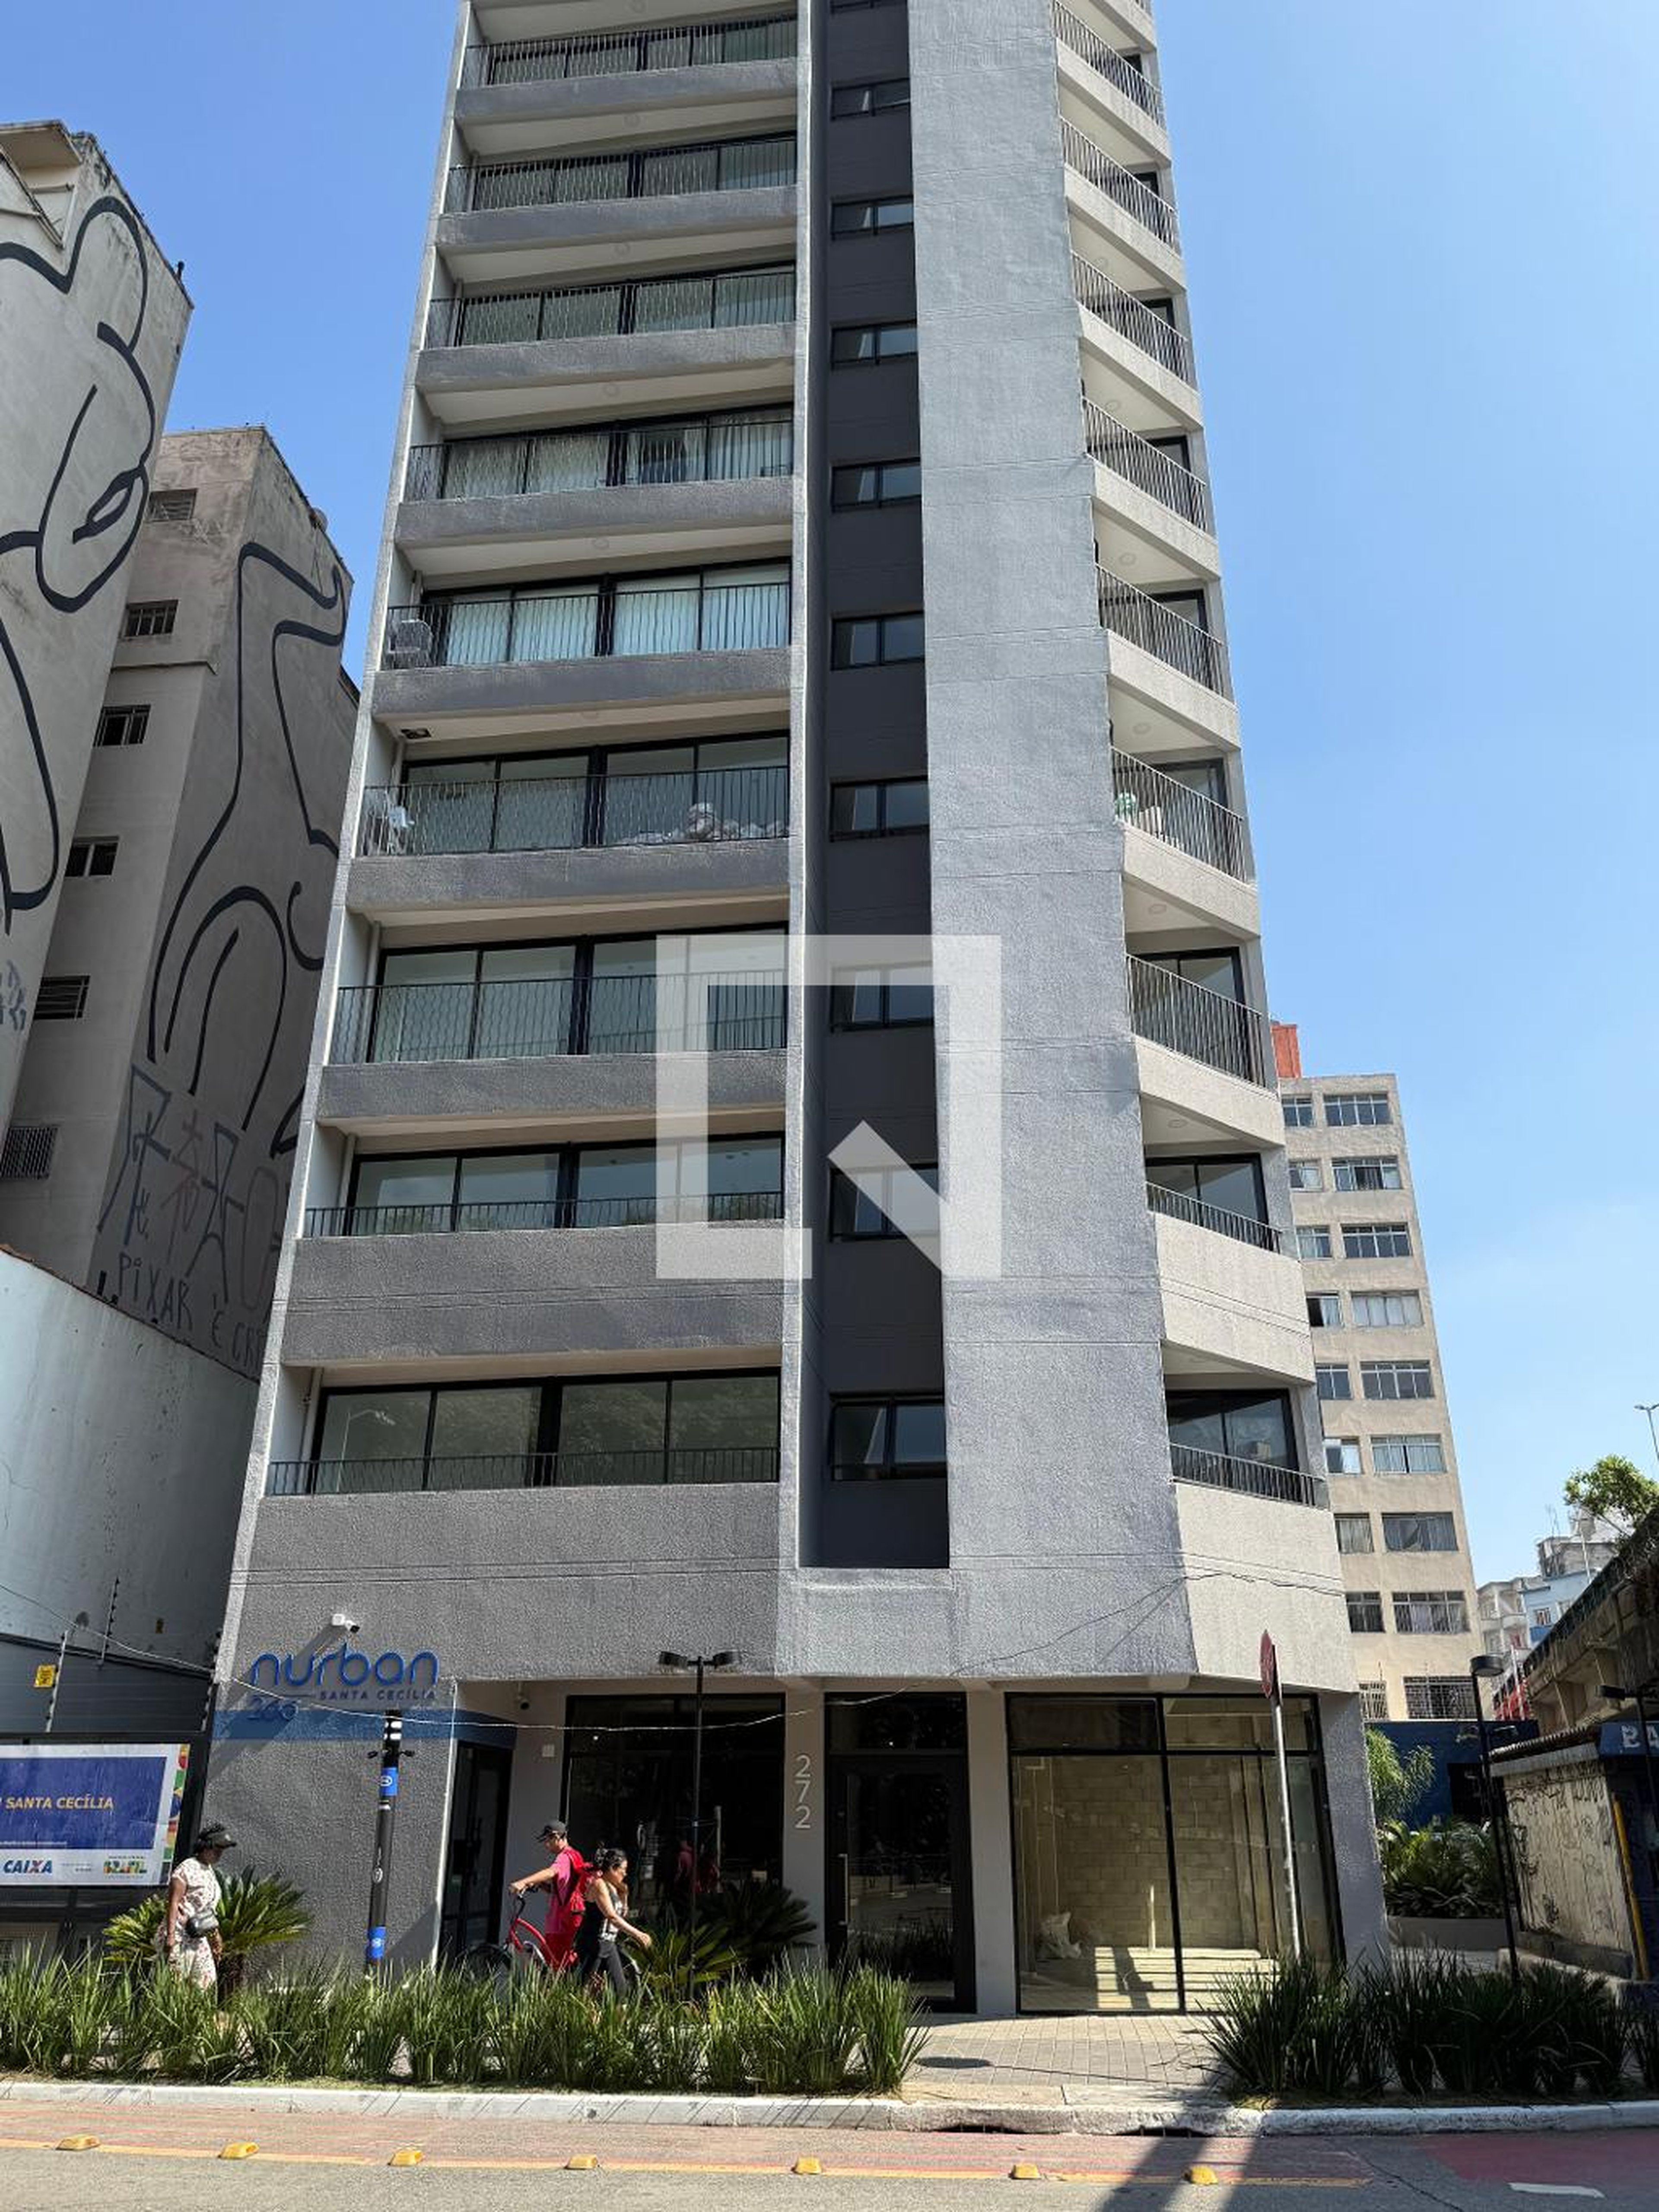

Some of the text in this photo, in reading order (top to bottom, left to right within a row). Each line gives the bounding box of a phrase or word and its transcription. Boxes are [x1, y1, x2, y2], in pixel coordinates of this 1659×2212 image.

[250, 1642, 439, 1686] nurban
[320, 1690, 368, 1700] SANTA
[795, 1754, 811, 1829] 272
[6, 1794, 114, 1809] SANTA CECÍLIA
[3, 1860, 52, 1873] CAIXA
